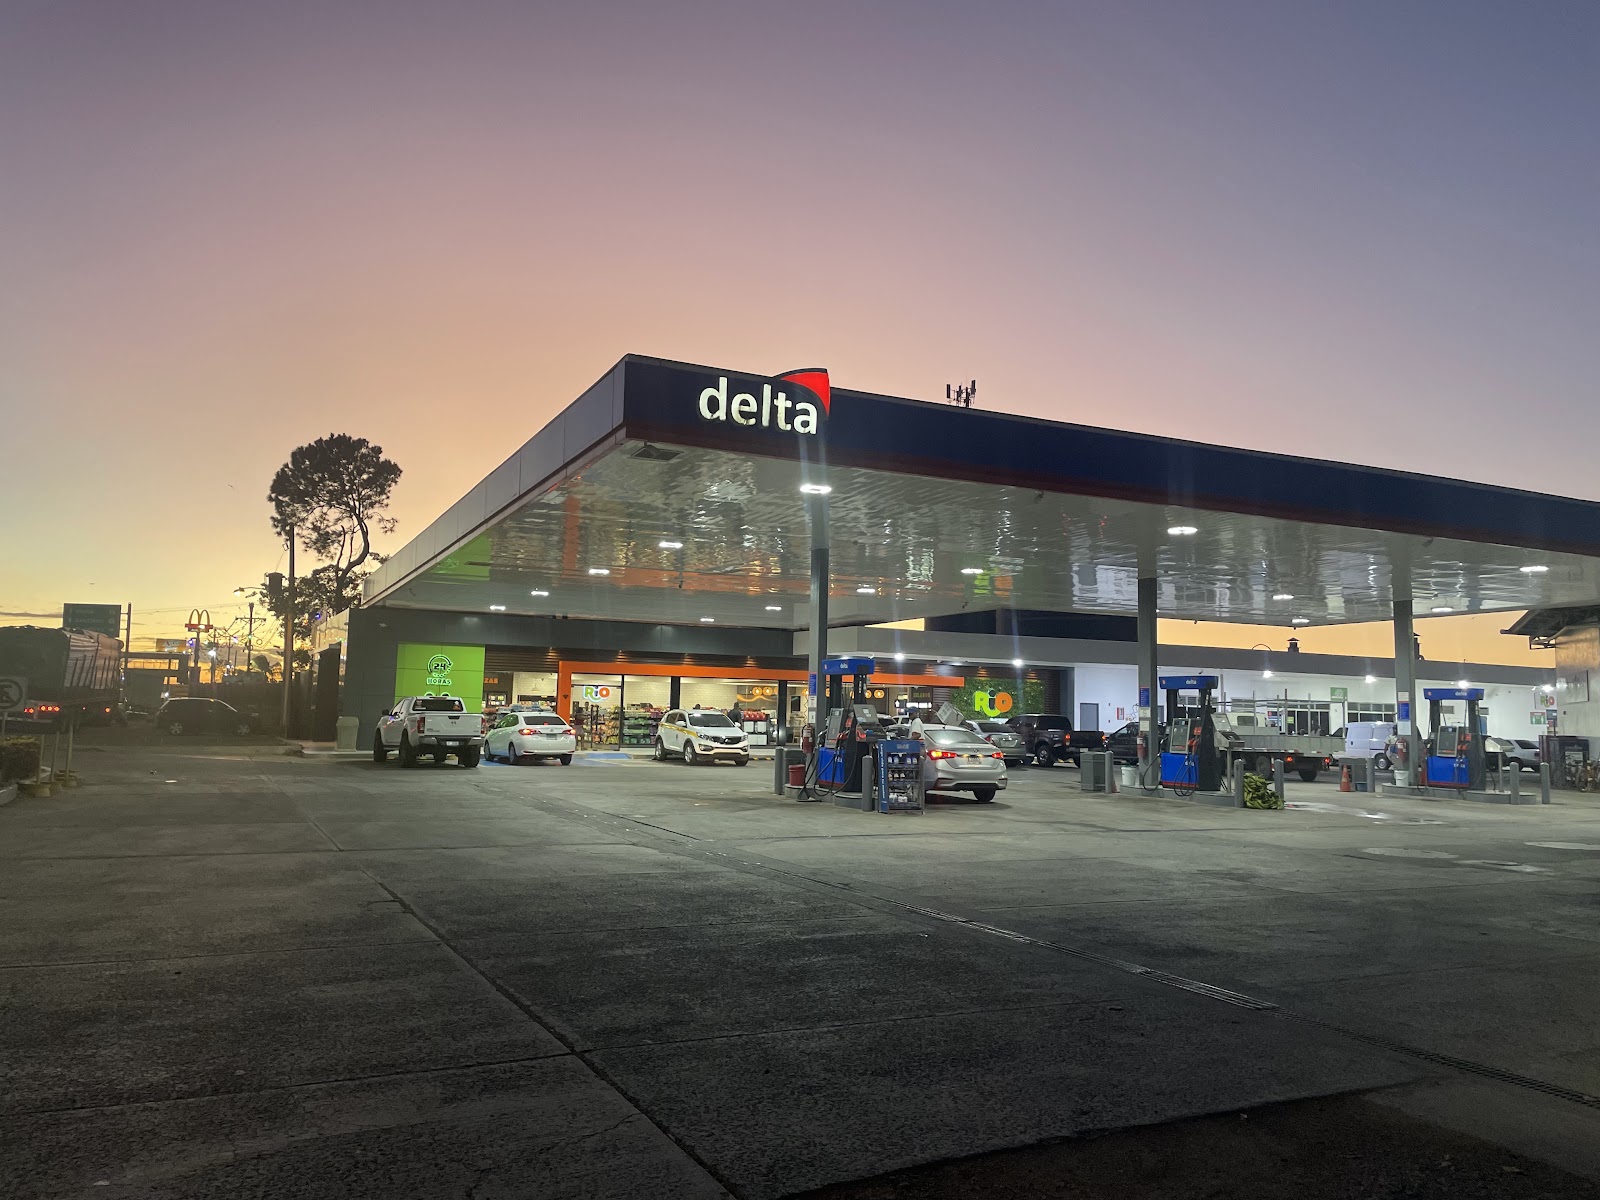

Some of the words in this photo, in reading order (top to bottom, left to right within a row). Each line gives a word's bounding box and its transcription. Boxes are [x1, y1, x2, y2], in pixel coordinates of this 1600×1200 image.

[699, 376, 817, 435] delta
[433, 662, 447, 671] 24
[427, 677, 452, 685] HORAS
